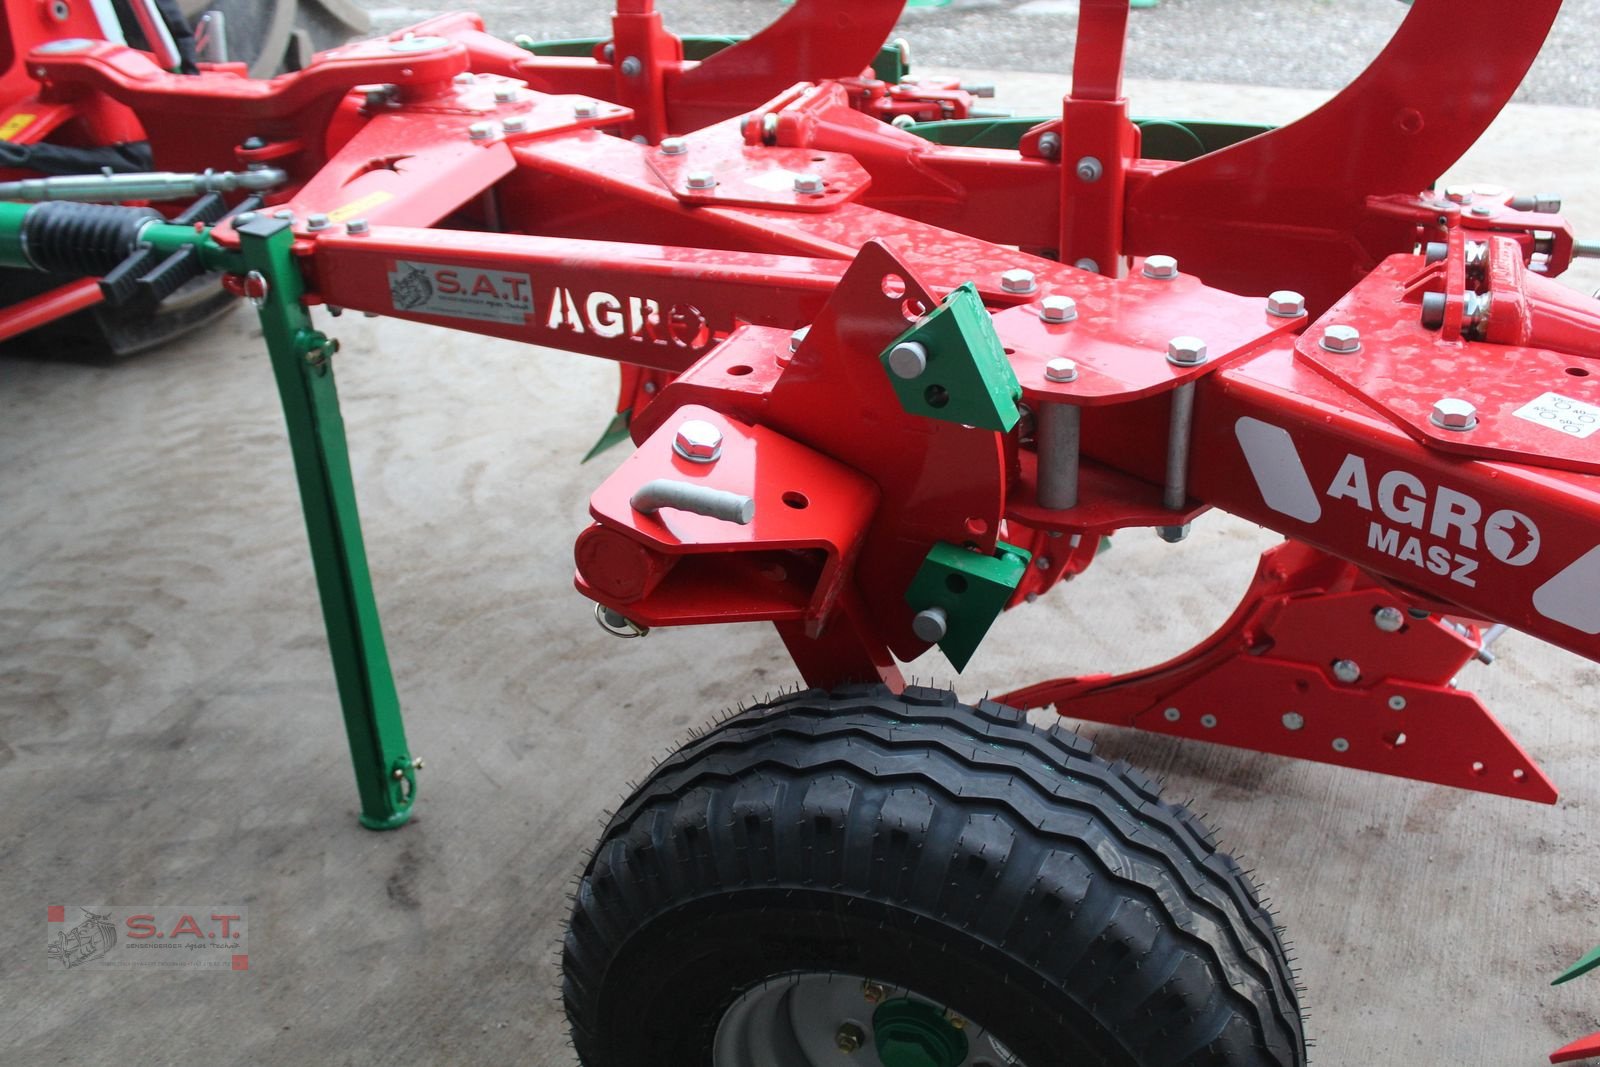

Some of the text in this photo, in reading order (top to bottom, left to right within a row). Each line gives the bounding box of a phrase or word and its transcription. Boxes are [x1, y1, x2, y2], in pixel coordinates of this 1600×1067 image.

[435, 269, 529, 303] S.A.T.
[1326, 453, 1541, 567] AGRO
[1367, 522, 1479, 588] MASZ
